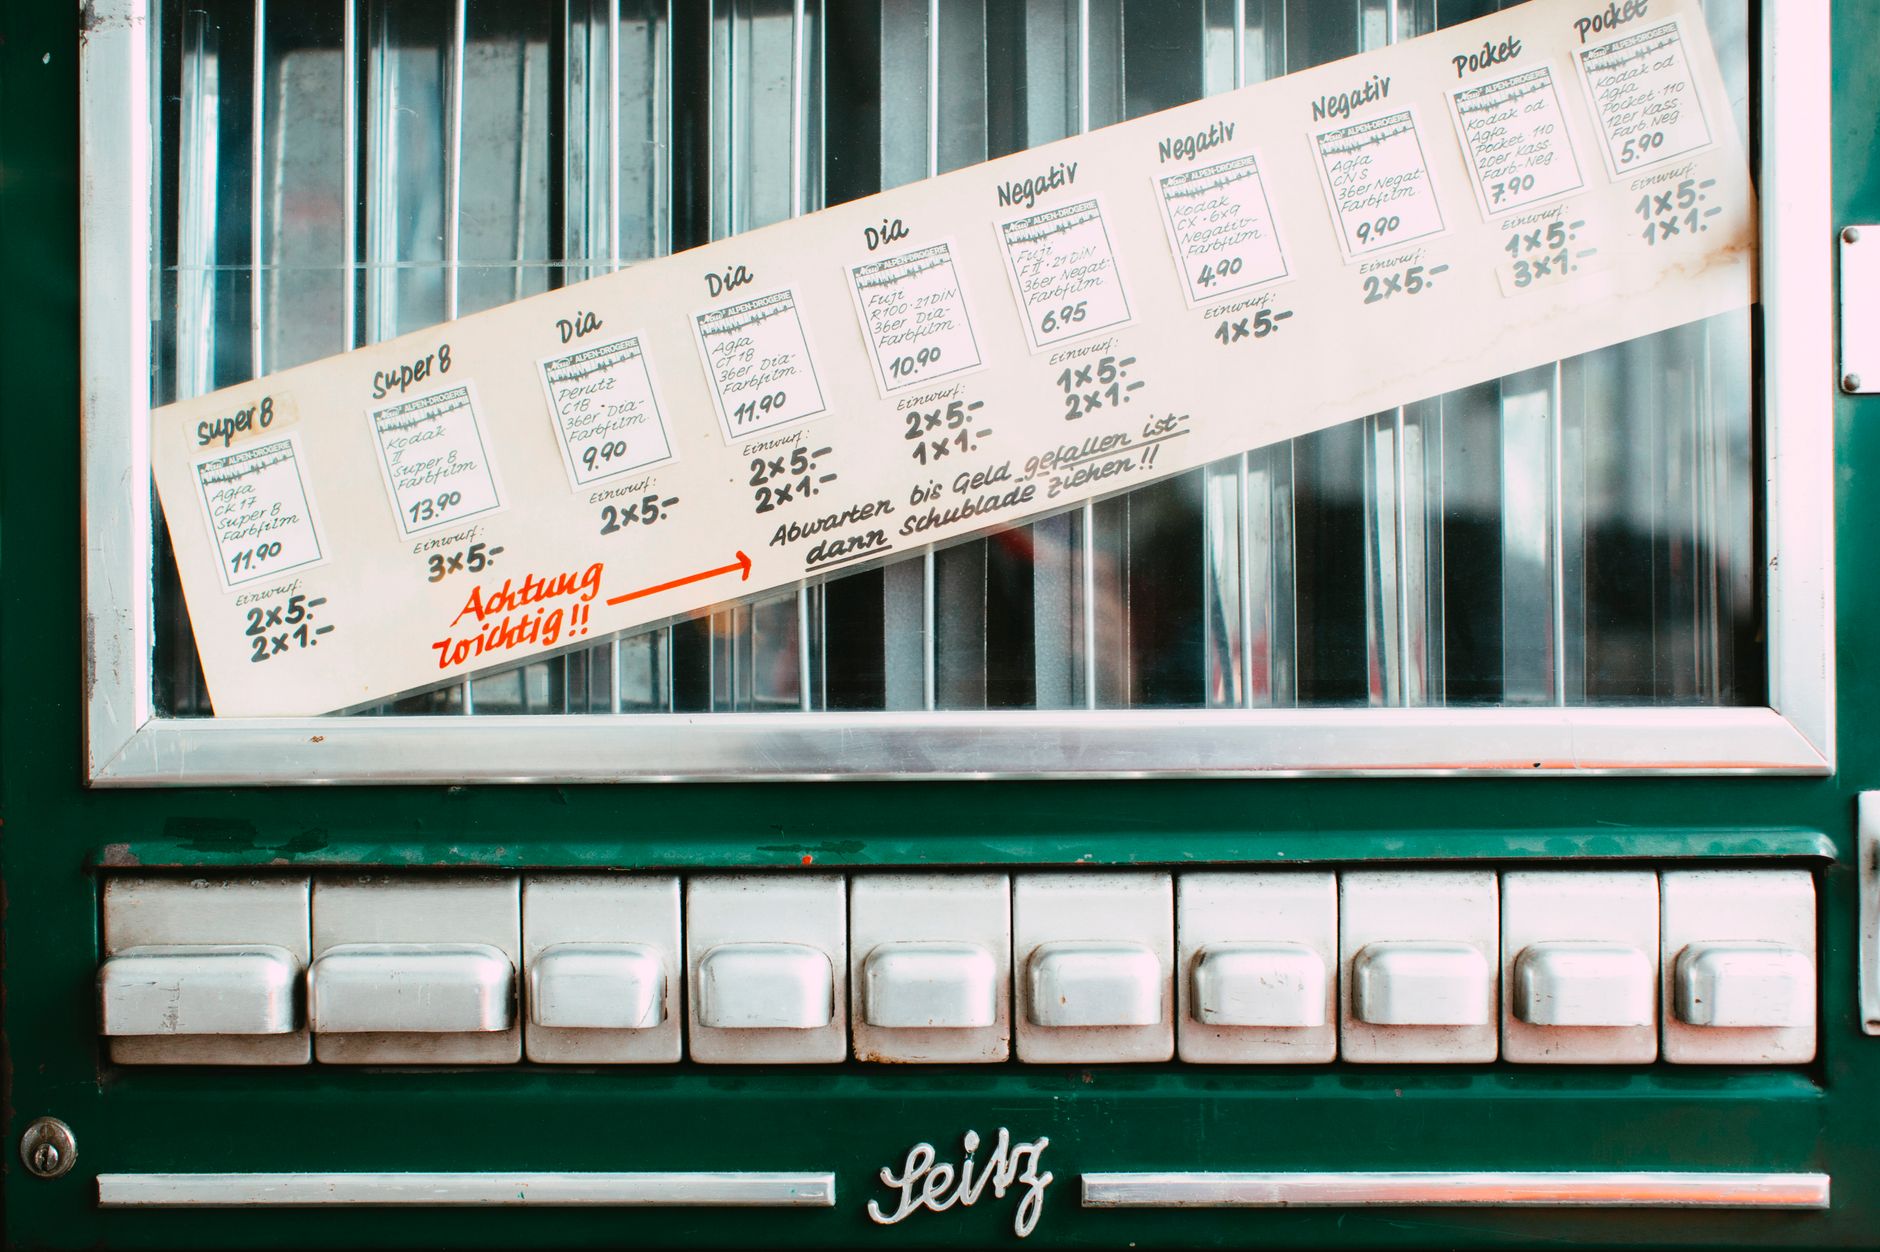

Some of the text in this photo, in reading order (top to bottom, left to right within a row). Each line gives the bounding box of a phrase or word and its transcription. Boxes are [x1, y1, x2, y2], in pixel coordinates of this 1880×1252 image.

[1574, 0, 1648, 43] Pocket
[1452, 35, 1522, 78] Pocket
[1596, 67, 1649, 89] Kodak
[1312, 75, 1390, 121] Negativ
[1600, 81, 1638, 101] Agfa
[1346, 112, 1410, 136] ALPEN-DROGERIE
[1467, 108, 1518, 131] Kodak
[1158, 121, 1235, 163] Negativ
[1470, 127, 1507, 145] Agfa
[1621, 132, 1664, 164] 5.90
[1190, 156, 1254, 179] ALPEN-DROGERIE
[1331, 154, 1373, 174] Agfa
[997, 162, 1077, 208] Negativ
[1338, 182, 1372, 201] 36er
[1491, 174, 1534, 204] 7.90
[1032, 200, 1097, 224] ALPEN-DROGERIE
[1173, 196, 1230, 217] Kodak
[864, 219, 909, 250] Dia
[1357, 215, 1400, 244] 9.90
[883, 244, 947, 268] ALPEN-DROGERIE
[704, 266, 753, 297] Dia
[1023, 275, 1056, 293] 36er
[1198, 257, 1243, 287] 4.90
[727, 291, 791, 316] ALPEN-DROGERIE
[868, 289, 905, 307] Fuji
[556, 311, 603, 344] Dia
[874, 319, 907, 334] 36er
[1041, 301, 1088, 333] 6.95
[574, 338, 638, 362] ALPEN-DROGERIE
[712, 336, 754, 355] Agfa
[372, 344, 451, 399] Super 8
[720, 366, 754, 383] 36er
[889, 347, 941, 379] 10.90
[403, 388, 466, 412] ALPEN-DROGERIE
[559, 377, 616, 401] Perutz
[734, 392, 786, 425] 11.90
[198, 396, 273, 447] Super 8
[566, 413, 600, 430] 36er
[387, 425, 446, 450] Kodak
[227, 440, 290, 464] ALPEN-DROGERIE
[447, 450, 458, 464] 8
[582, 441, 627, 471] 9.90
[212, 485, 255, 504] Agfa
[769, 497, 895, 546] Abwarten
[911, 479, 940, 507] bis
[952, 460, 1011, 494] Geld
[1025, 434, 1131, 480] gefallen
[271, 502, 282, 516] 8
[409, 491, 461, 523] 13.90
[806, 528, 888, 564] dann
[899, 483, 1036, 536] Schublade
[231, 542, 282, 573] 11.90
[450, 562, 604, 627] Achtung
[868, 1127, 1053, 1237] Seitz
